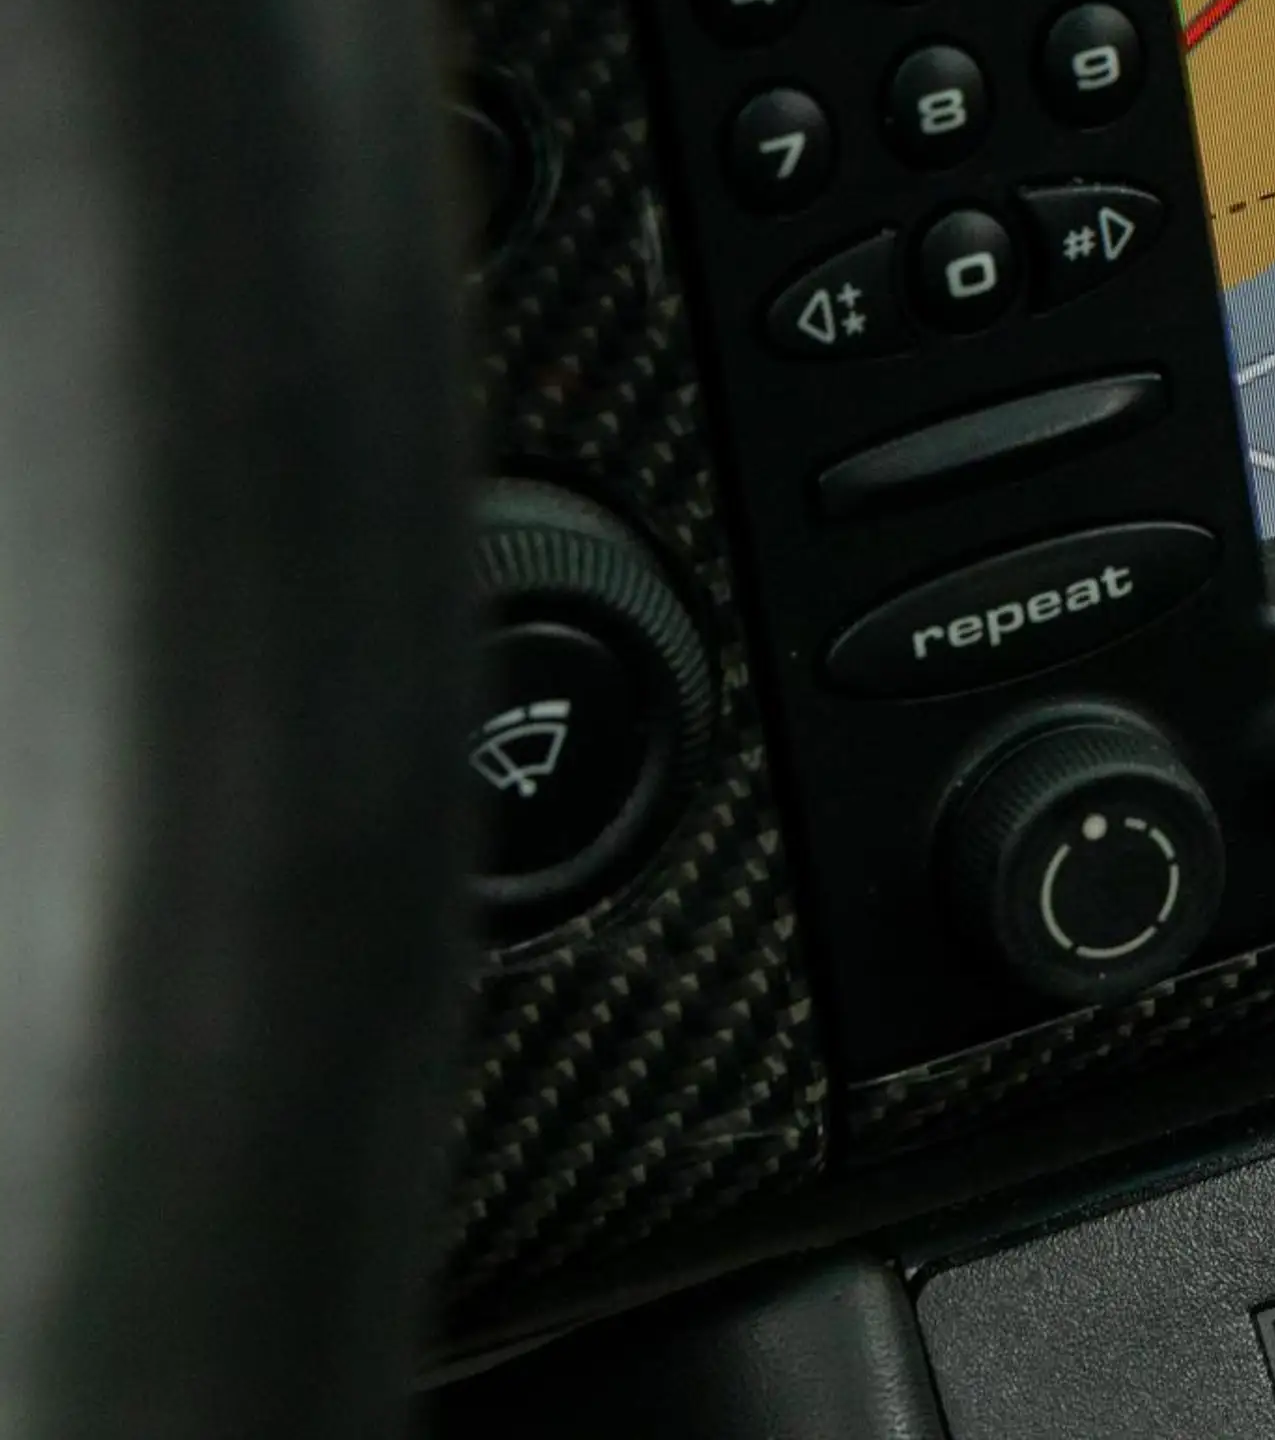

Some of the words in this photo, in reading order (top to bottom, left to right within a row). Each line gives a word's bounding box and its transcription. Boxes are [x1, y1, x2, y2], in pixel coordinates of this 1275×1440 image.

[1071, 45, 1121, 90] 9
[917, 88, 967, 134] 8
[759, 131, 806, 179] 7
[911, 565, 1134, 660] repeat
